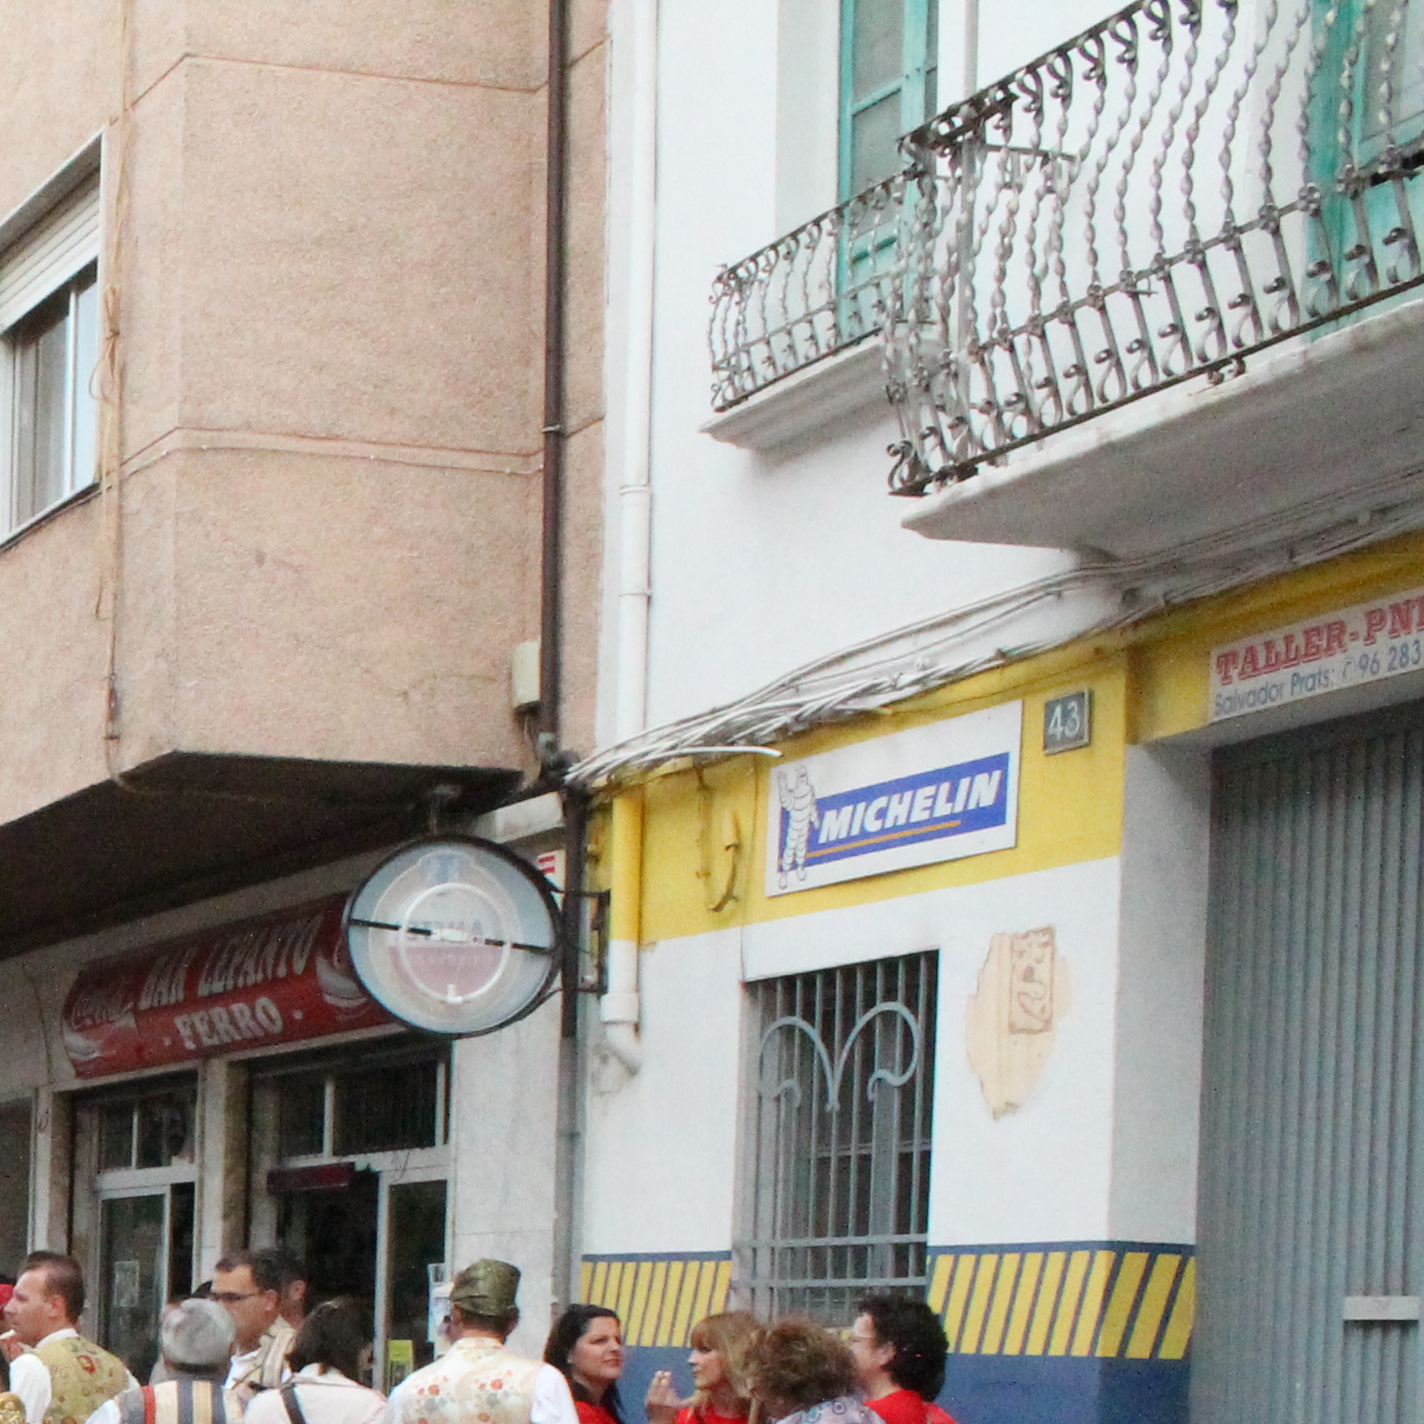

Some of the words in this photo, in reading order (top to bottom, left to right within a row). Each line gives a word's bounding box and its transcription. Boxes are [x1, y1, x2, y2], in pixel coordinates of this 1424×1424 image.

[1215, 683, 1284, 716] Salvador
[1358, 652, 1380, 677] 96
[1388, 640, 1421, 672] 283
[1047, 700, 1081, 741] 43
[817, 769, 1003, 844] MICHELIN
[137, 946, 199, 1010] BAR
[174, 996, 284, 1050] FERRO
